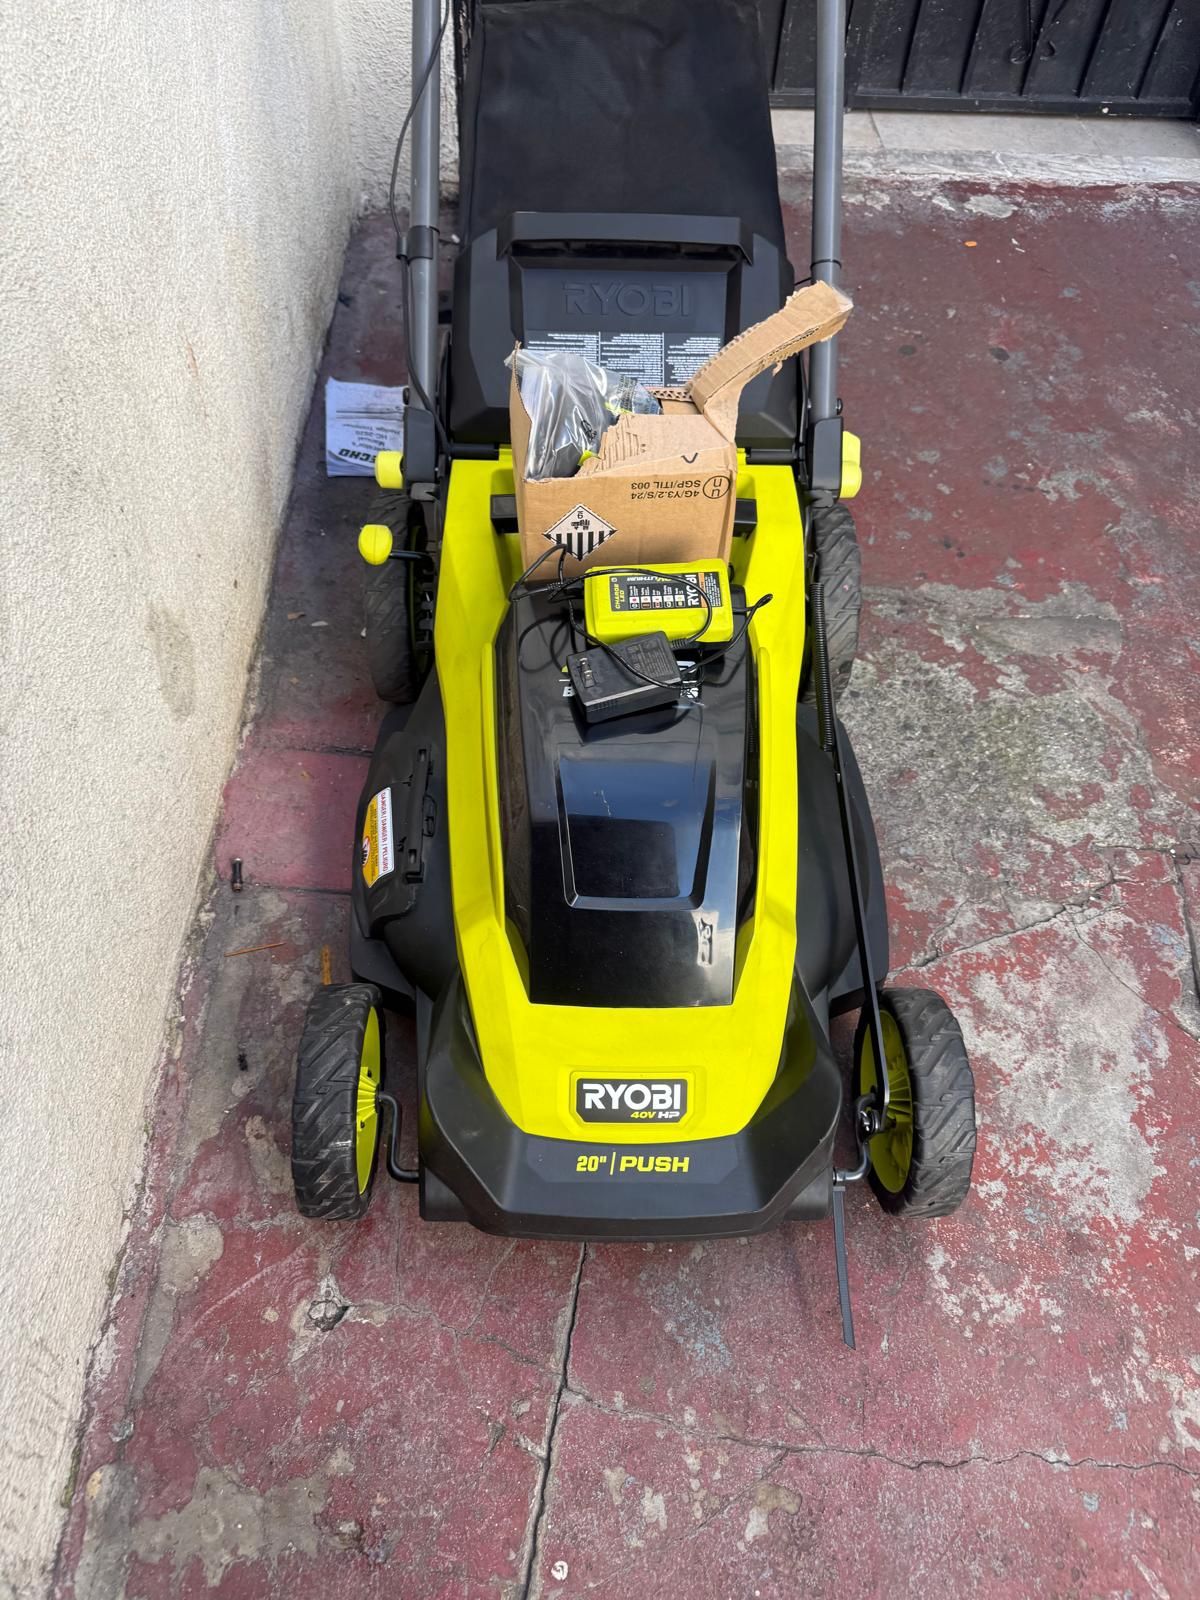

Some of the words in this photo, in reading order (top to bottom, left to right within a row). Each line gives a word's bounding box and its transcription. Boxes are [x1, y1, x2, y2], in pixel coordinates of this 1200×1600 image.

[561, 281, 689, 317] RYOBI
[631, 482, 650, 490] 003
[654, 480, 701, 489] SGP/ITIL
[631, 490, 700, 500] 4G/Y3.2/S/24
[582, 1083, 681, 1110] RYOBI
[630, 1111, 657, 1119] 40V
[657, 1111, 680, 1119] HP
[576, 1155, 607, 1172] 20"
[619, 1155, 690, 1173] PUSH
